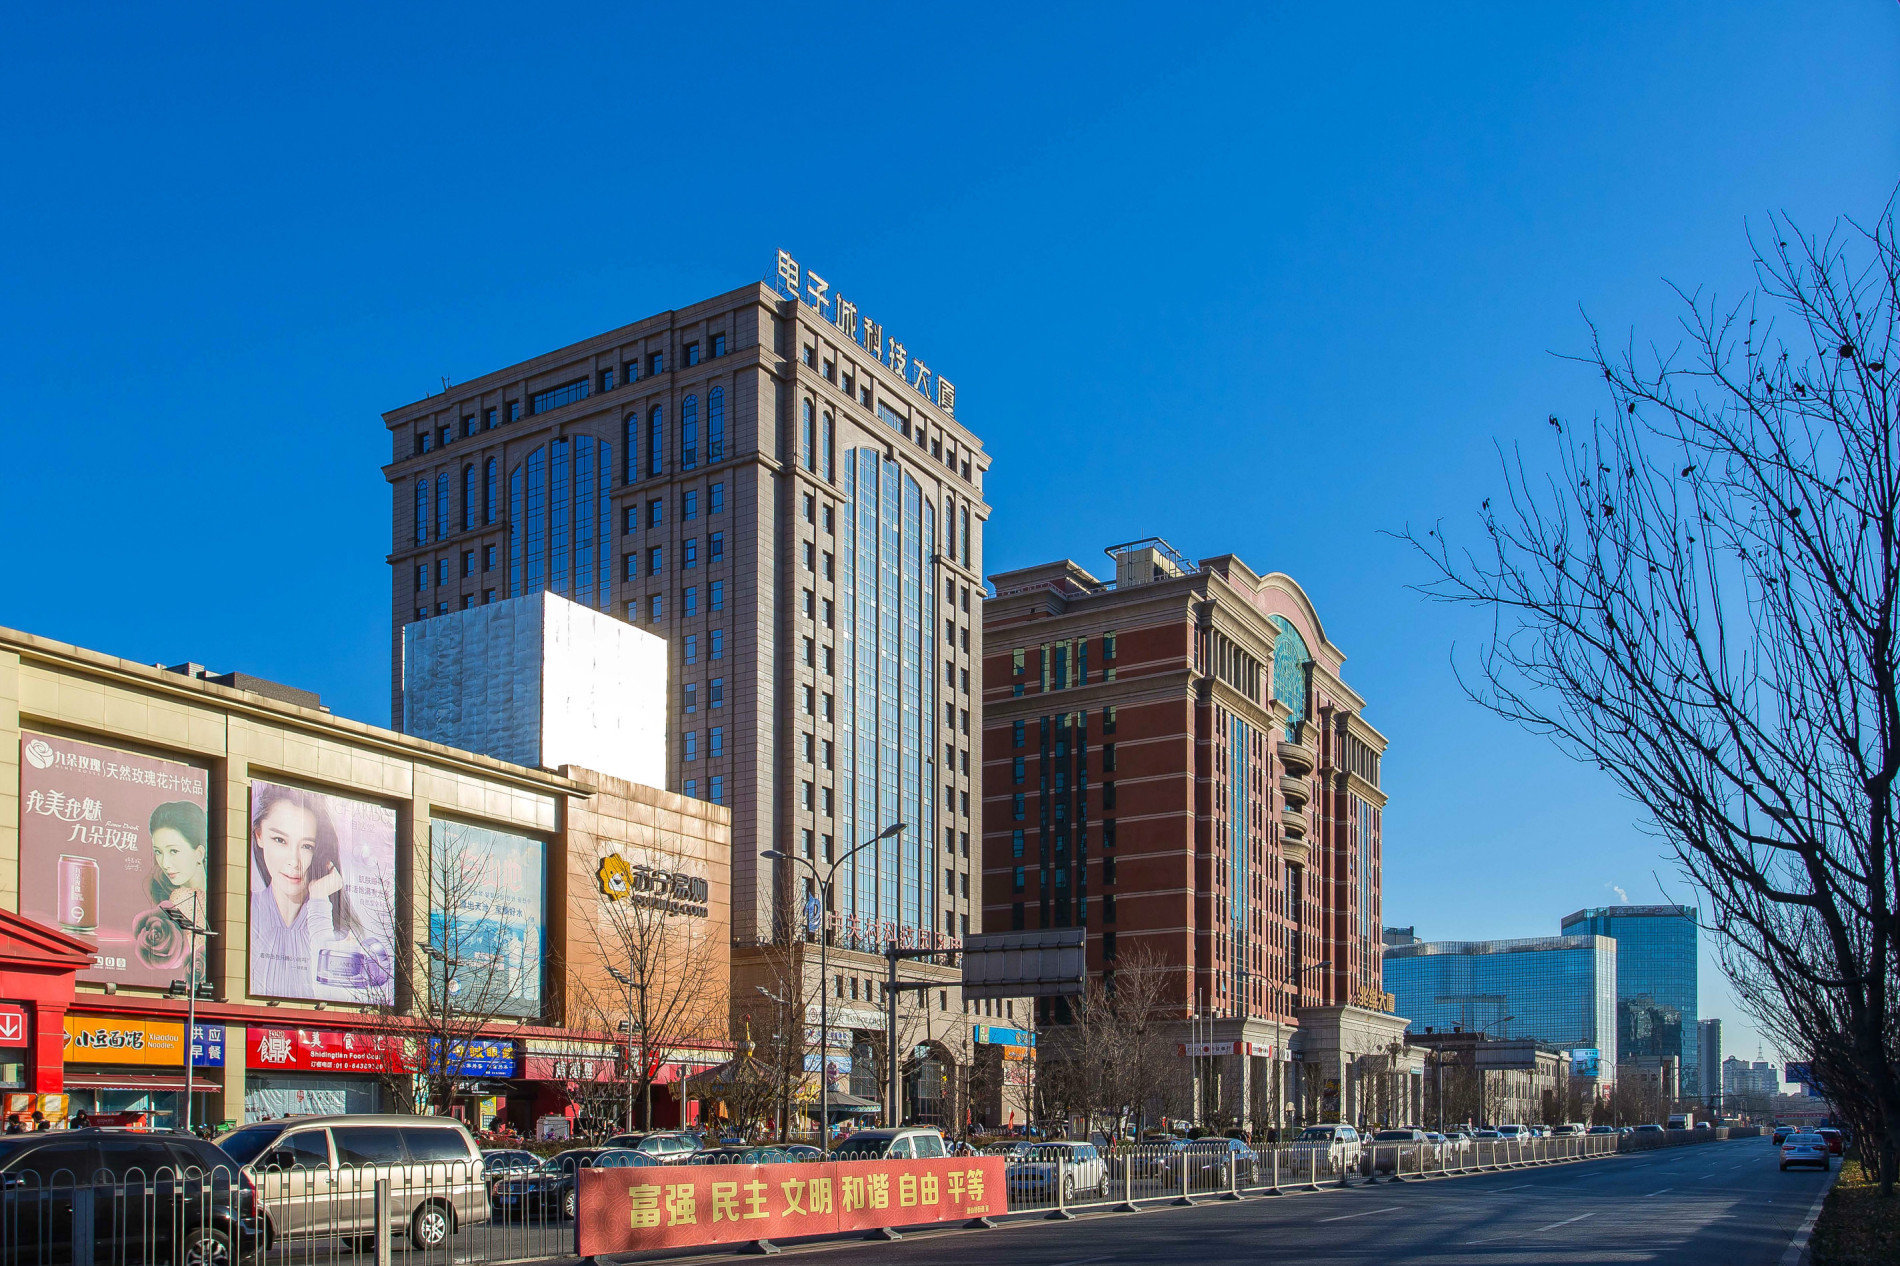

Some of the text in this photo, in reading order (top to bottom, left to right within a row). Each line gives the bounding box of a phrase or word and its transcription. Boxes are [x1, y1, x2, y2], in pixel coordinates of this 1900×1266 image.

[778, 248, 955, 417] 电子城科技大厦
[55, 751, 100, 772] 九朵玫瑰
[106, 763, 203, 795] 天然玫瑰花汁饮品
[26, 790, 102, 822] 我美我魅
[68, 823, 139, 852] 九朵玫瑰
[633, 864, 708, 903] 苏宁易购
[75, 1029, 145, 1049] 小豆面馆
[148, 1033, 178, 1042] Xiaodou
[192, 1026, 221, 1042] 供应
[147, 1041, 174, 1049] Noodles
[192, 1045, 221, 1059] 早餐
[310, 1051, 348, 1059] Shidingtian
[628, 1168, 985, 1228] 富强 民主 文明 和谐 自由 平等
